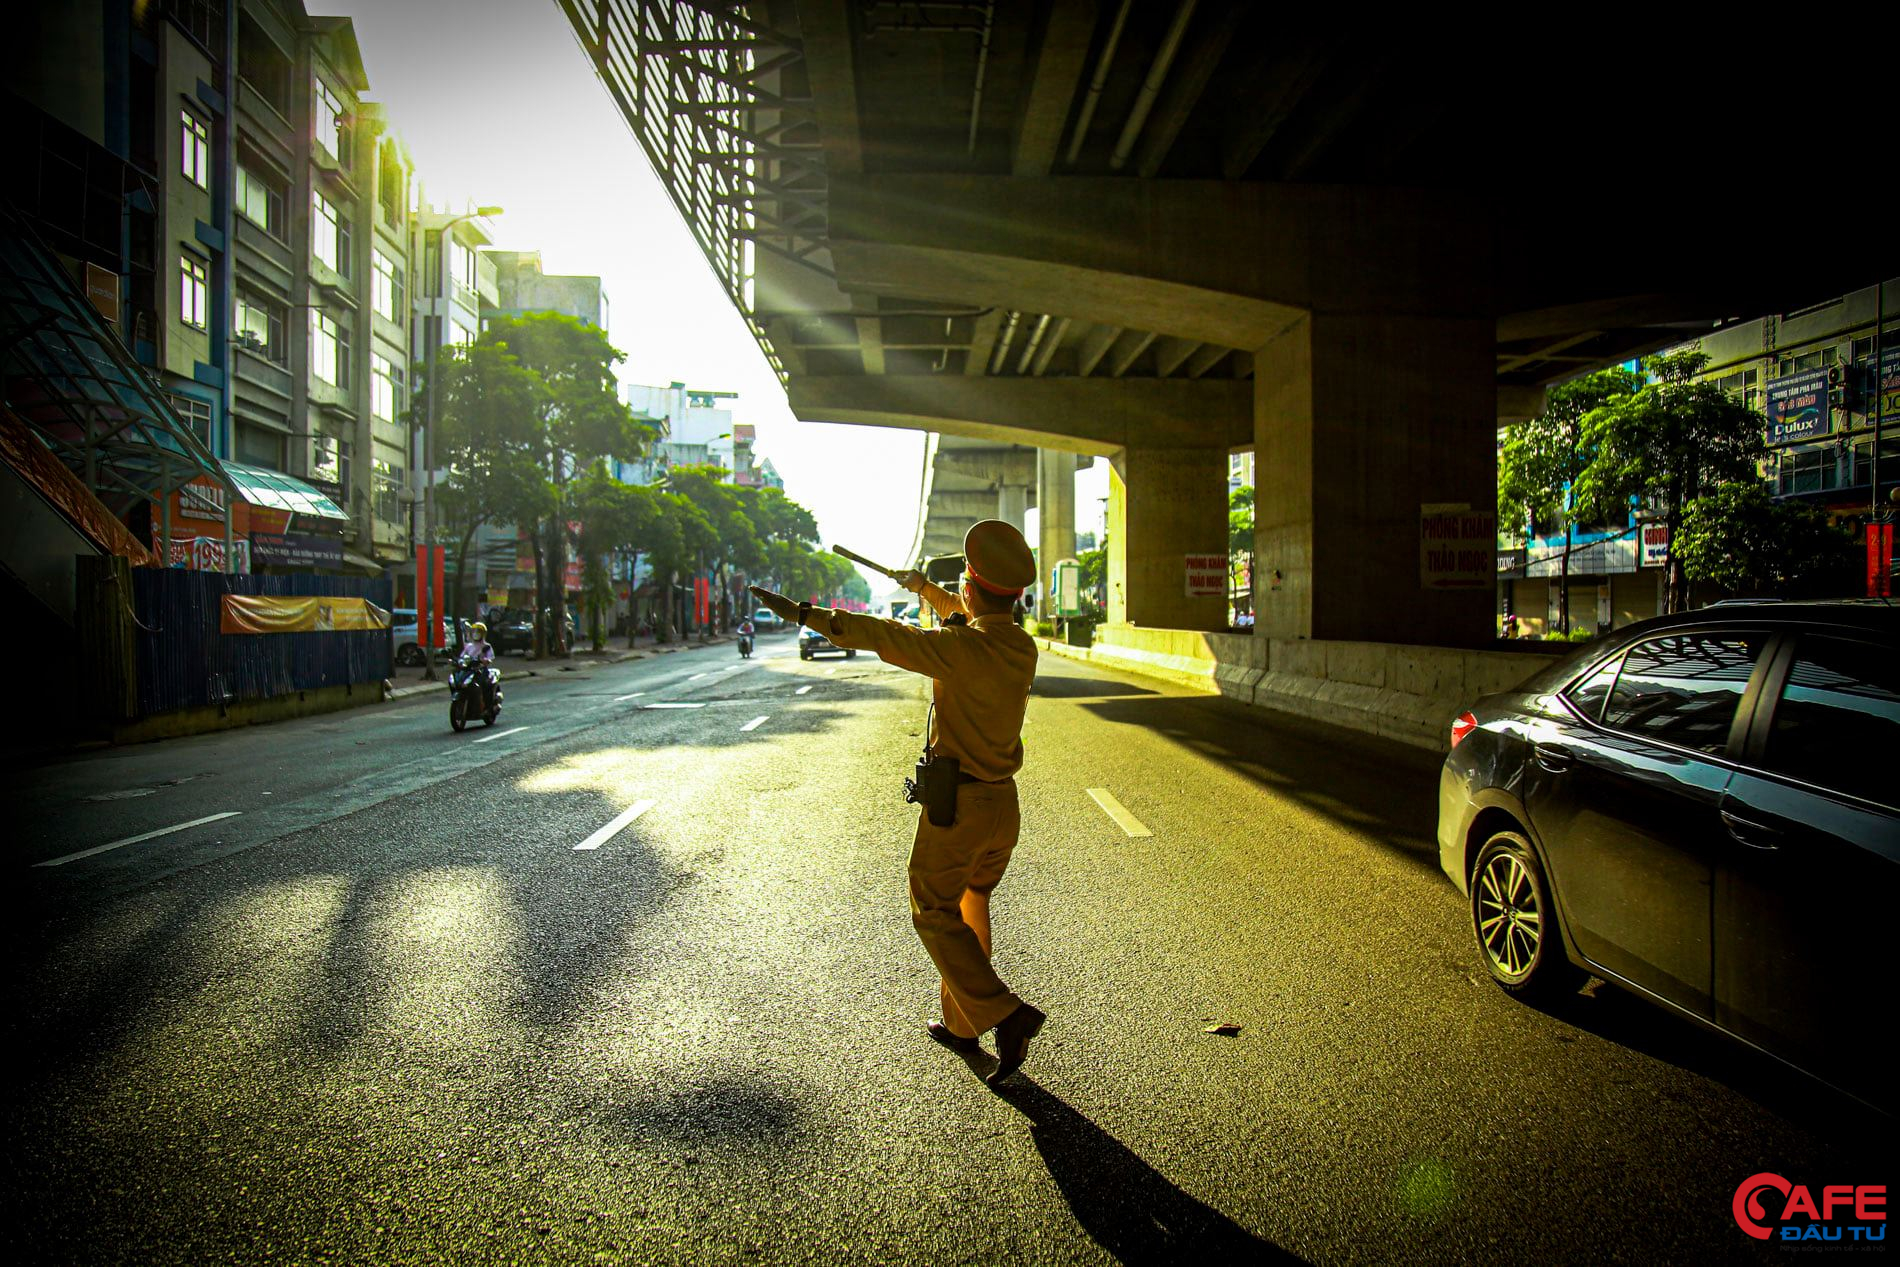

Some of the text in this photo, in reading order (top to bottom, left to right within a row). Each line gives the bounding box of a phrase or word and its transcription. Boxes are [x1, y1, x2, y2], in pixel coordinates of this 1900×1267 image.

[1775, 419, 1814, 437] Dulux
[1422, 514, 1458, 539] PHÒNG
[1458, 551, 1488, 576] NGỌC
